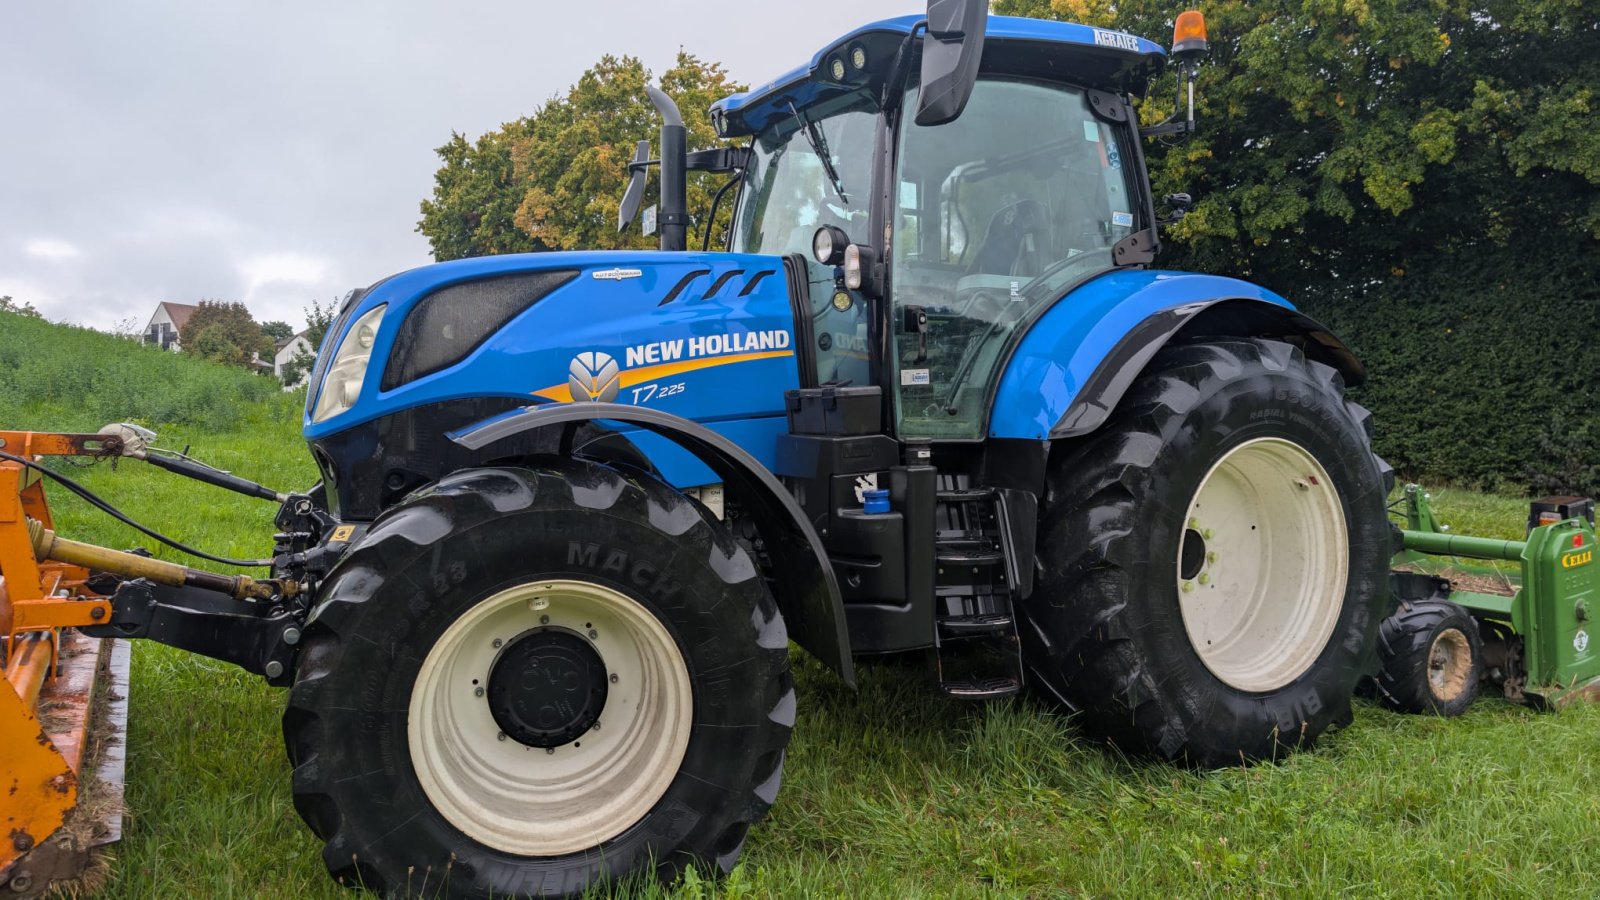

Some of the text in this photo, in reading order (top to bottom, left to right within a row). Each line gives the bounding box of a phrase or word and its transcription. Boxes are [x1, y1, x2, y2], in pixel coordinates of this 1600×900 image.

[626, 330, 790, 368] NEW HOLLAND
[632, 382, 686, 406] T7.225
[567, 541, 682, 599] MACH
[1561, 550, 1593, 569] CELLI
